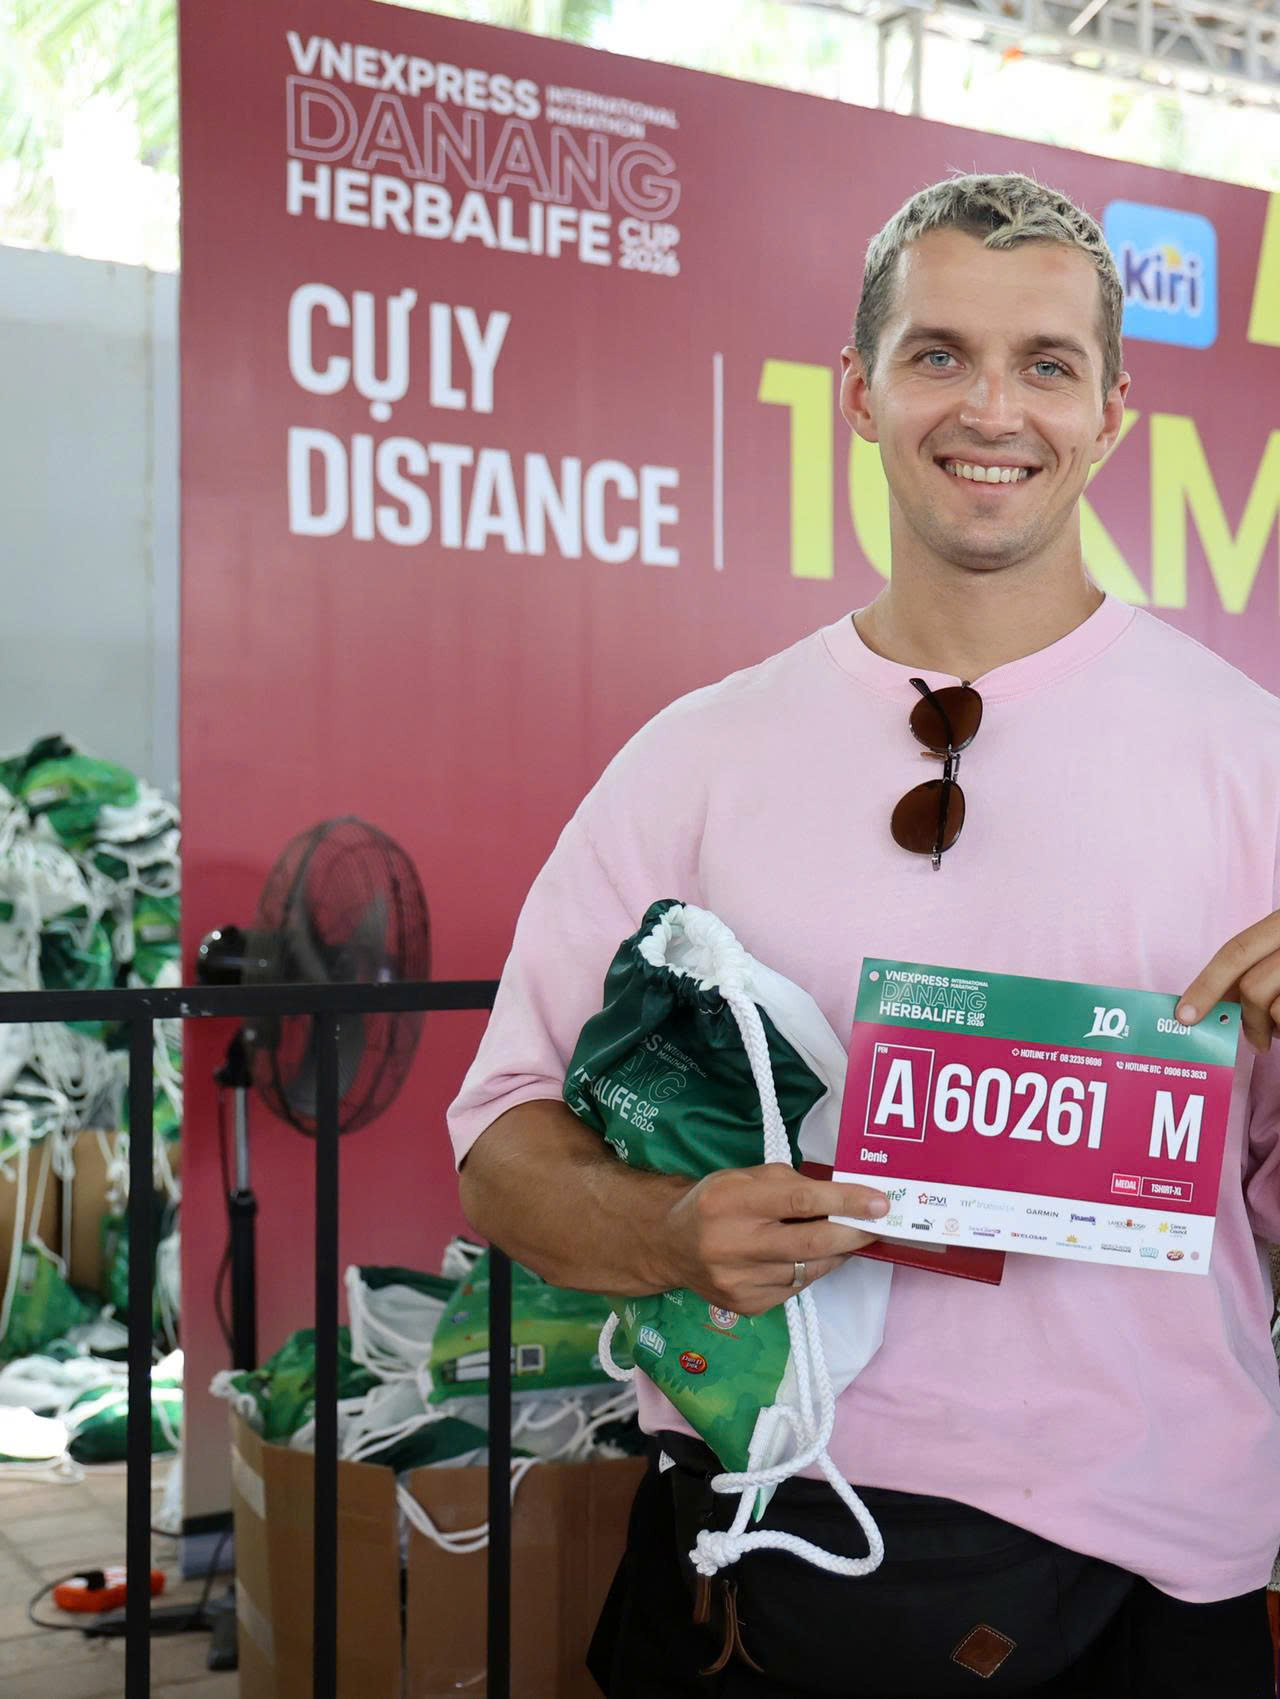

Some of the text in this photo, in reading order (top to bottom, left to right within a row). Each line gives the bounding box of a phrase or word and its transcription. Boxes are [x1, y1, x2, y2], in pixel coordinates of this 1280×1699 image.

[287, 31, 540, 119] VNEXPRESS
[286, 74, 682, 222] DANANG
[286, 159, 612, 266] HERBALIFE
[618, 217, 681, 248] CUP
[1122, 246, 1199, 310] Kiri
[288, 282, 511, 423] CỰ LY
[288, 427, 680, 568] DISTANCE
[885, 970, 949, 988] VNEXPRESS
[881, 980, 987, 1012] DANANG
[879, 1000, 966, 1025] HERBALIFE
[966, 1019, 984, 1027] 2026
[967, 1012, 985, 1021] CUP
[1088, 1006, 1127, 1037] 10
[1020, 1049, 1045, 1060] HOTLINE
[1125, 1061, 1150, 1072] HOTLINE
[873, 1058, 915, 1129] A
[933, 1063, 1107, 1149] 60261
[636, 1100, 660, 1119] CUP
[630, 1112, 655, 1133] 2026
[1148, 1090, 1205, 1163] M
[860, 1148, 888, 1164] Denis
[1114, 1178, 1137, 1190] MEDAL
[1151, 1183, 1182, 1196] TSHIRT-XL
[1026, 1208, 1059, 1218] GARMIN
[1070, 1213, 1096, 1225] Vinamilk
